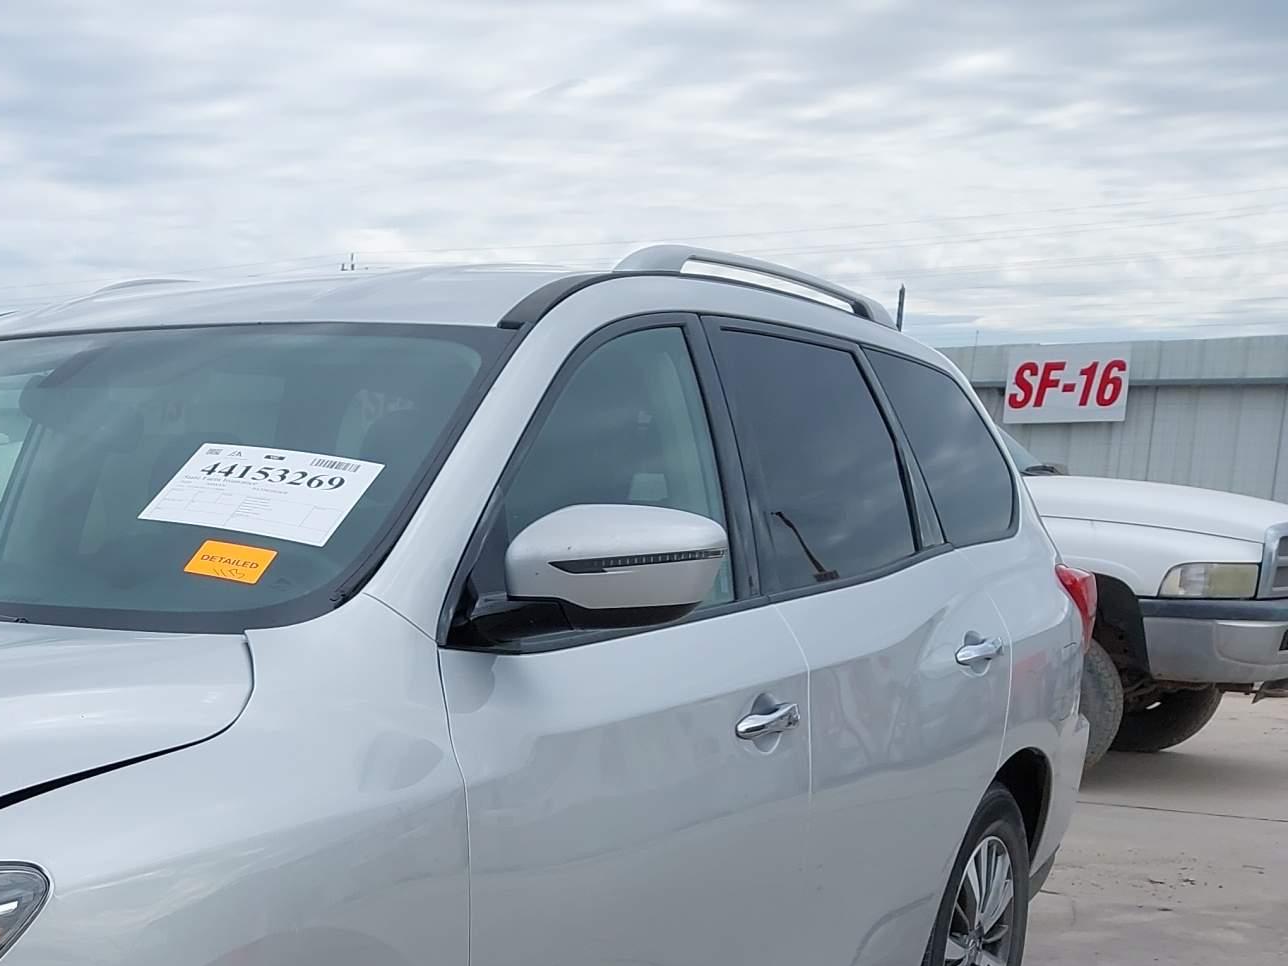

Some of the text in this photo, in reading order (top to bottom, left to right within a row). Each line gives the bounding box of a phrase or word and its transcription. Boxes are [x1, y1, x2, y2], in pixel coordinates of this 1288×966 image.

[1008, 359, 1127, 409] SF-16
[201, 461, 346, 491] 44153269
[201, 554, 259, 569] DETAILED
